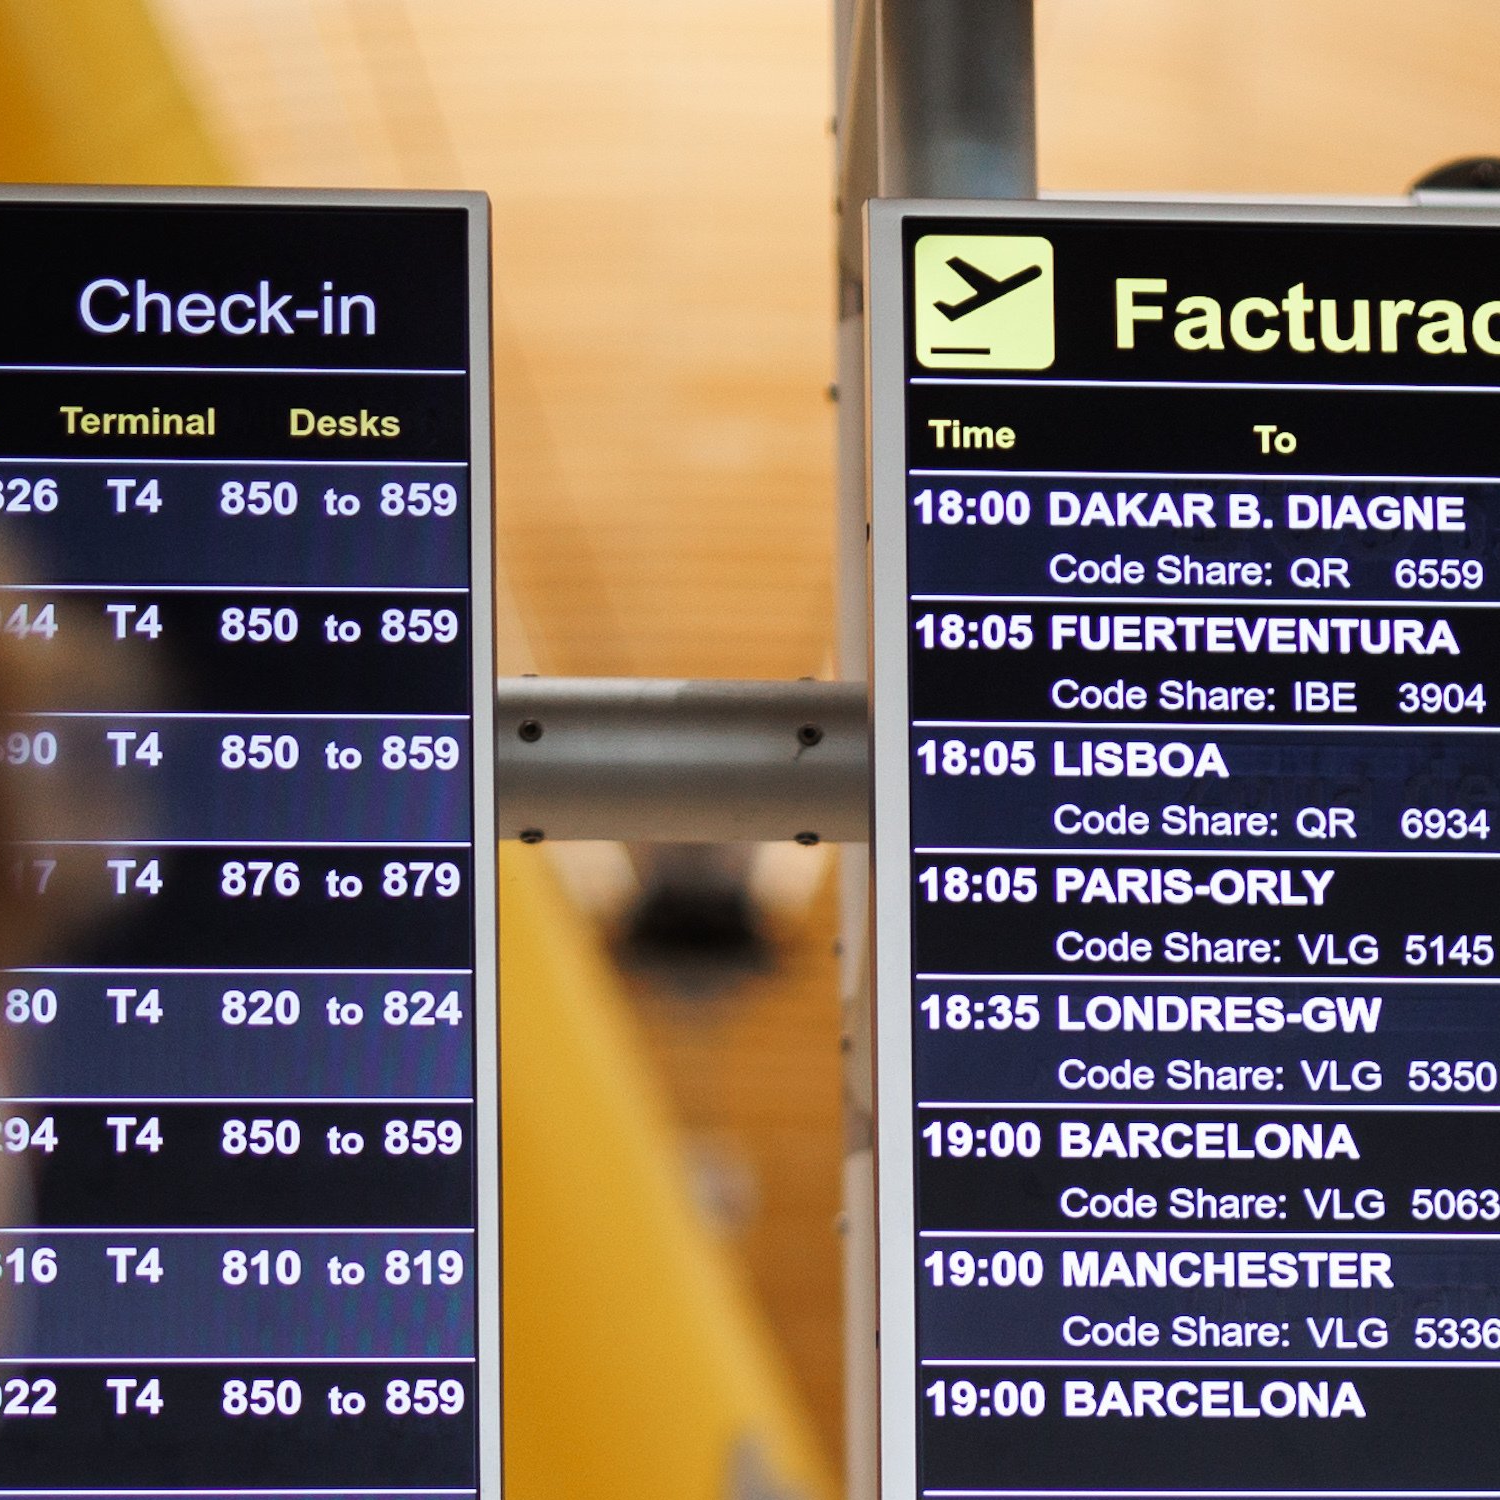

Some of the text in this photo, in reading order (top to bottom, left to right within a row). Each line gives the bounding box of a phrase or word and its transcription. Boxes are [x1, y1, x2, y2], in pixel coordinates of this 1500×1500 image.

[79, 278, 376, 335] Check-in
[59, 406, 215, 436] Terminal
[290, 408, 401, 437] Desks
[927, 419, 1016, 449] Time
[1253, 424, 1297, 454] To
[106, 478, 163, 513] T4
[220, 481, 298, 516] 850
[323, 488, 361, 516] to
[380, 482, 458, 517] 859
[913, 489, 1031, 526] 18:00
[1049, 491, 1217, 529] DAKAR
[1229, 493, 1274, 529] B.
[1287, 494, 1466, 532] DIAGNE
[1049, 553, 1484, 590] Code Share: QR 6559
[915, 613, 1033, 650] 18:05
[1051, 614, 1461, 655] FUERTEVENTURA
[917, 739, 1036, 776] 18:05
[1053, 740, 1230, 778] LISBOA
[918, 866, 1038, 903] 18:05
[1055, 867, 1335, 906] PARIS-ORLY
[1056, 930, 1495, 966] Code Share: VLG 5145
[920, 994, 1040, 1030] 18:35
[1058, 994, 1383, 1033] LONDRES-GW
[922, 1121, 1042, 1158] 19:00
[1060, 1122, 1361, 1160] BARCELONA
[1060, 1187, 1158, 1219] Code
[1169, 1187, 1287, 1219] Share:
[1303, 1188, 1386, 1220] VLG
[106, 1247, 164, 1283] T4
[222, 1249, 302, 1286] 810
[327, 1256, 366, 1285] to
[385, 1249, 464, 1285] 819
[924, 1250, 1044, 1287] 19:00
[1062, 1250, 1395, 1289] MANCHESTER
[106, 1378, 164, 1415] T4
[222, 1379, 302, 1415] 850
[327, 1385, 366, 1415] to
[385, 1379, 465, 1415] 859
[926, 1380, 1046, 1417] 19:00
[1064, 1380, 1367, 1418] BARCELONA
